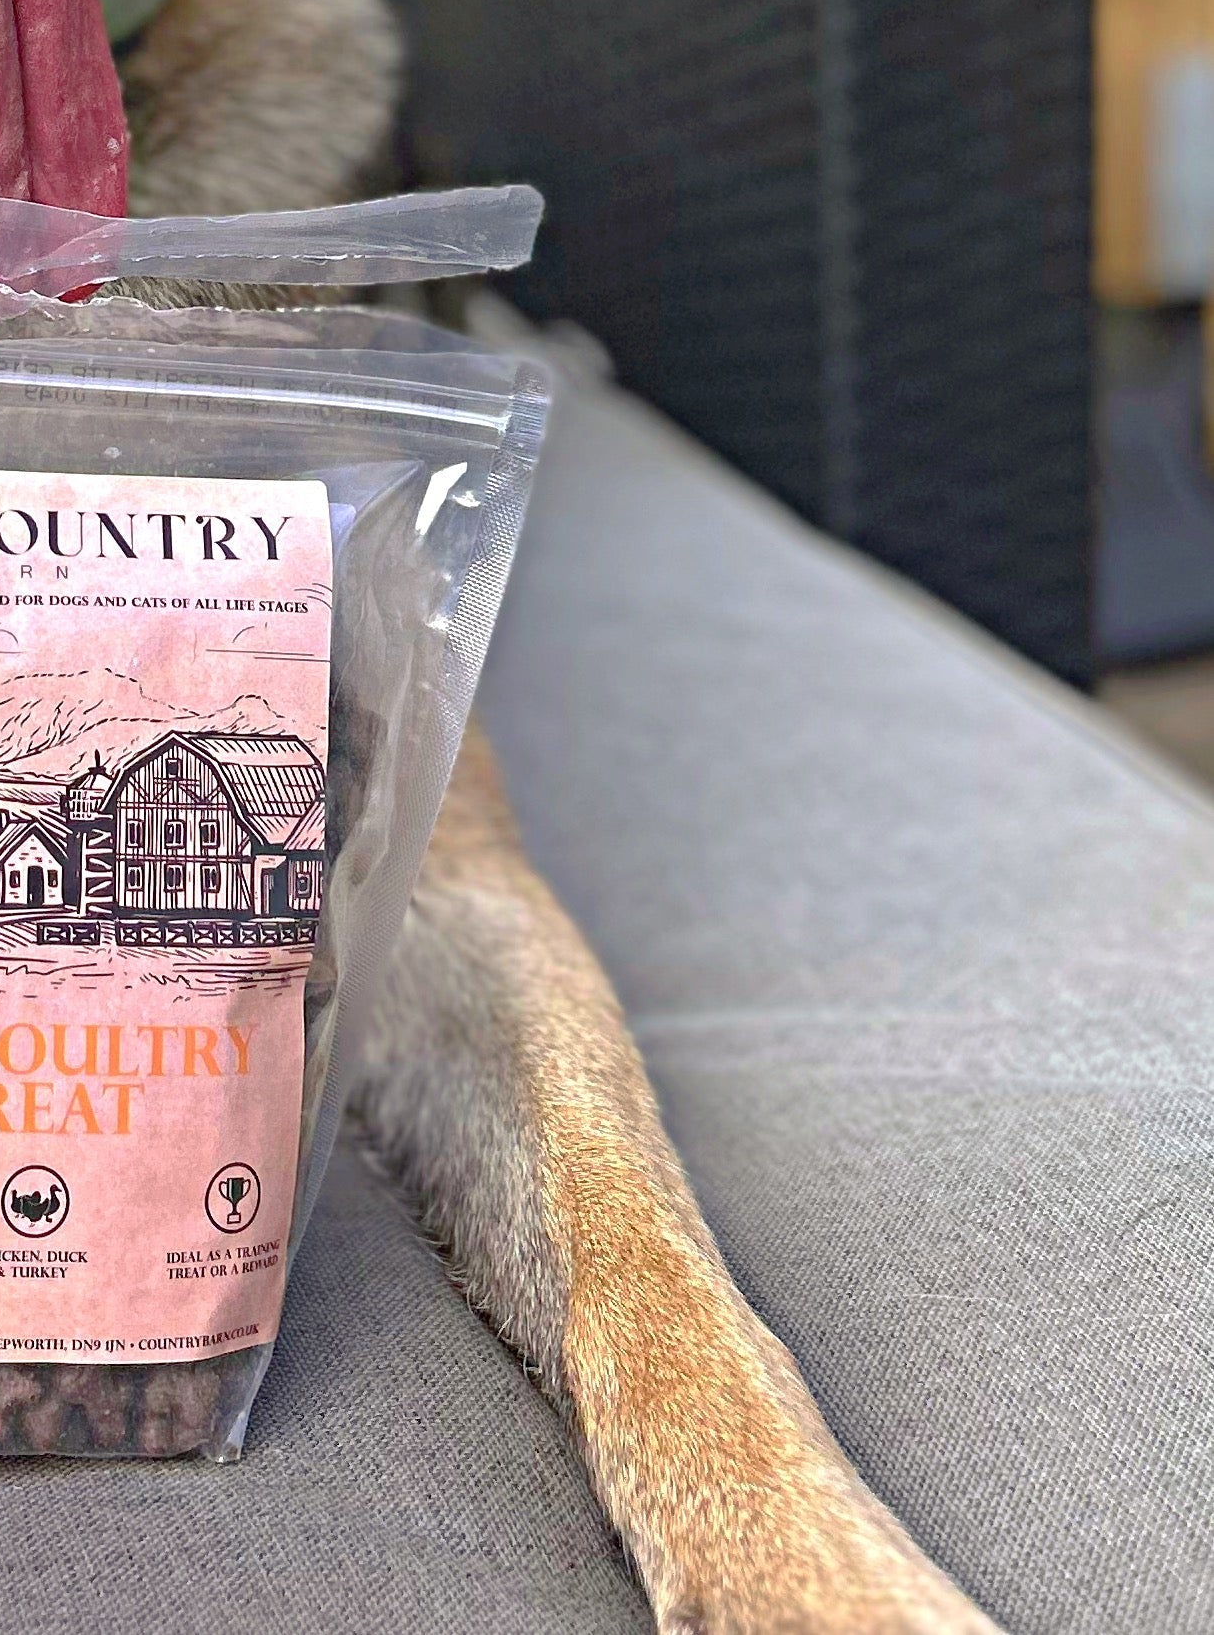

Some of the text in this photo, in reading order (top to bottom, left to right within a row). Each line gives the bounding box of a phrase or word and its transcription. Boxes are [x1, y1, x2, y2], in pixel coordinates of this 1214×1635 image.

[14, 594, 45, 606] FOR
[49, 595, 90, 607] DOGS
[93, 596, 127, 608] AND
[131, 597, 168, 609] CATS
[171, 597, 190, 610] OF
[194, 597, 222, 611] ALL
[225, 598, 256, 612] LIFE
[258, 600, 309, 614] STAGES
[47, 1250, 89, 1264] DUCK
[166, 1250, 204, 1264] IDEAL
[206, 1249, 222, 1262] AS
[224, 1248, 233, 1260] A
[9, 1266, 69, 1279] TURKEY
[166, 1265, 207, 1280] TREAT
[210, 1264, 228, 1278] OR
[230, 1263, 239, 1275] A
[72, 1338, 101, 1351] DN9
